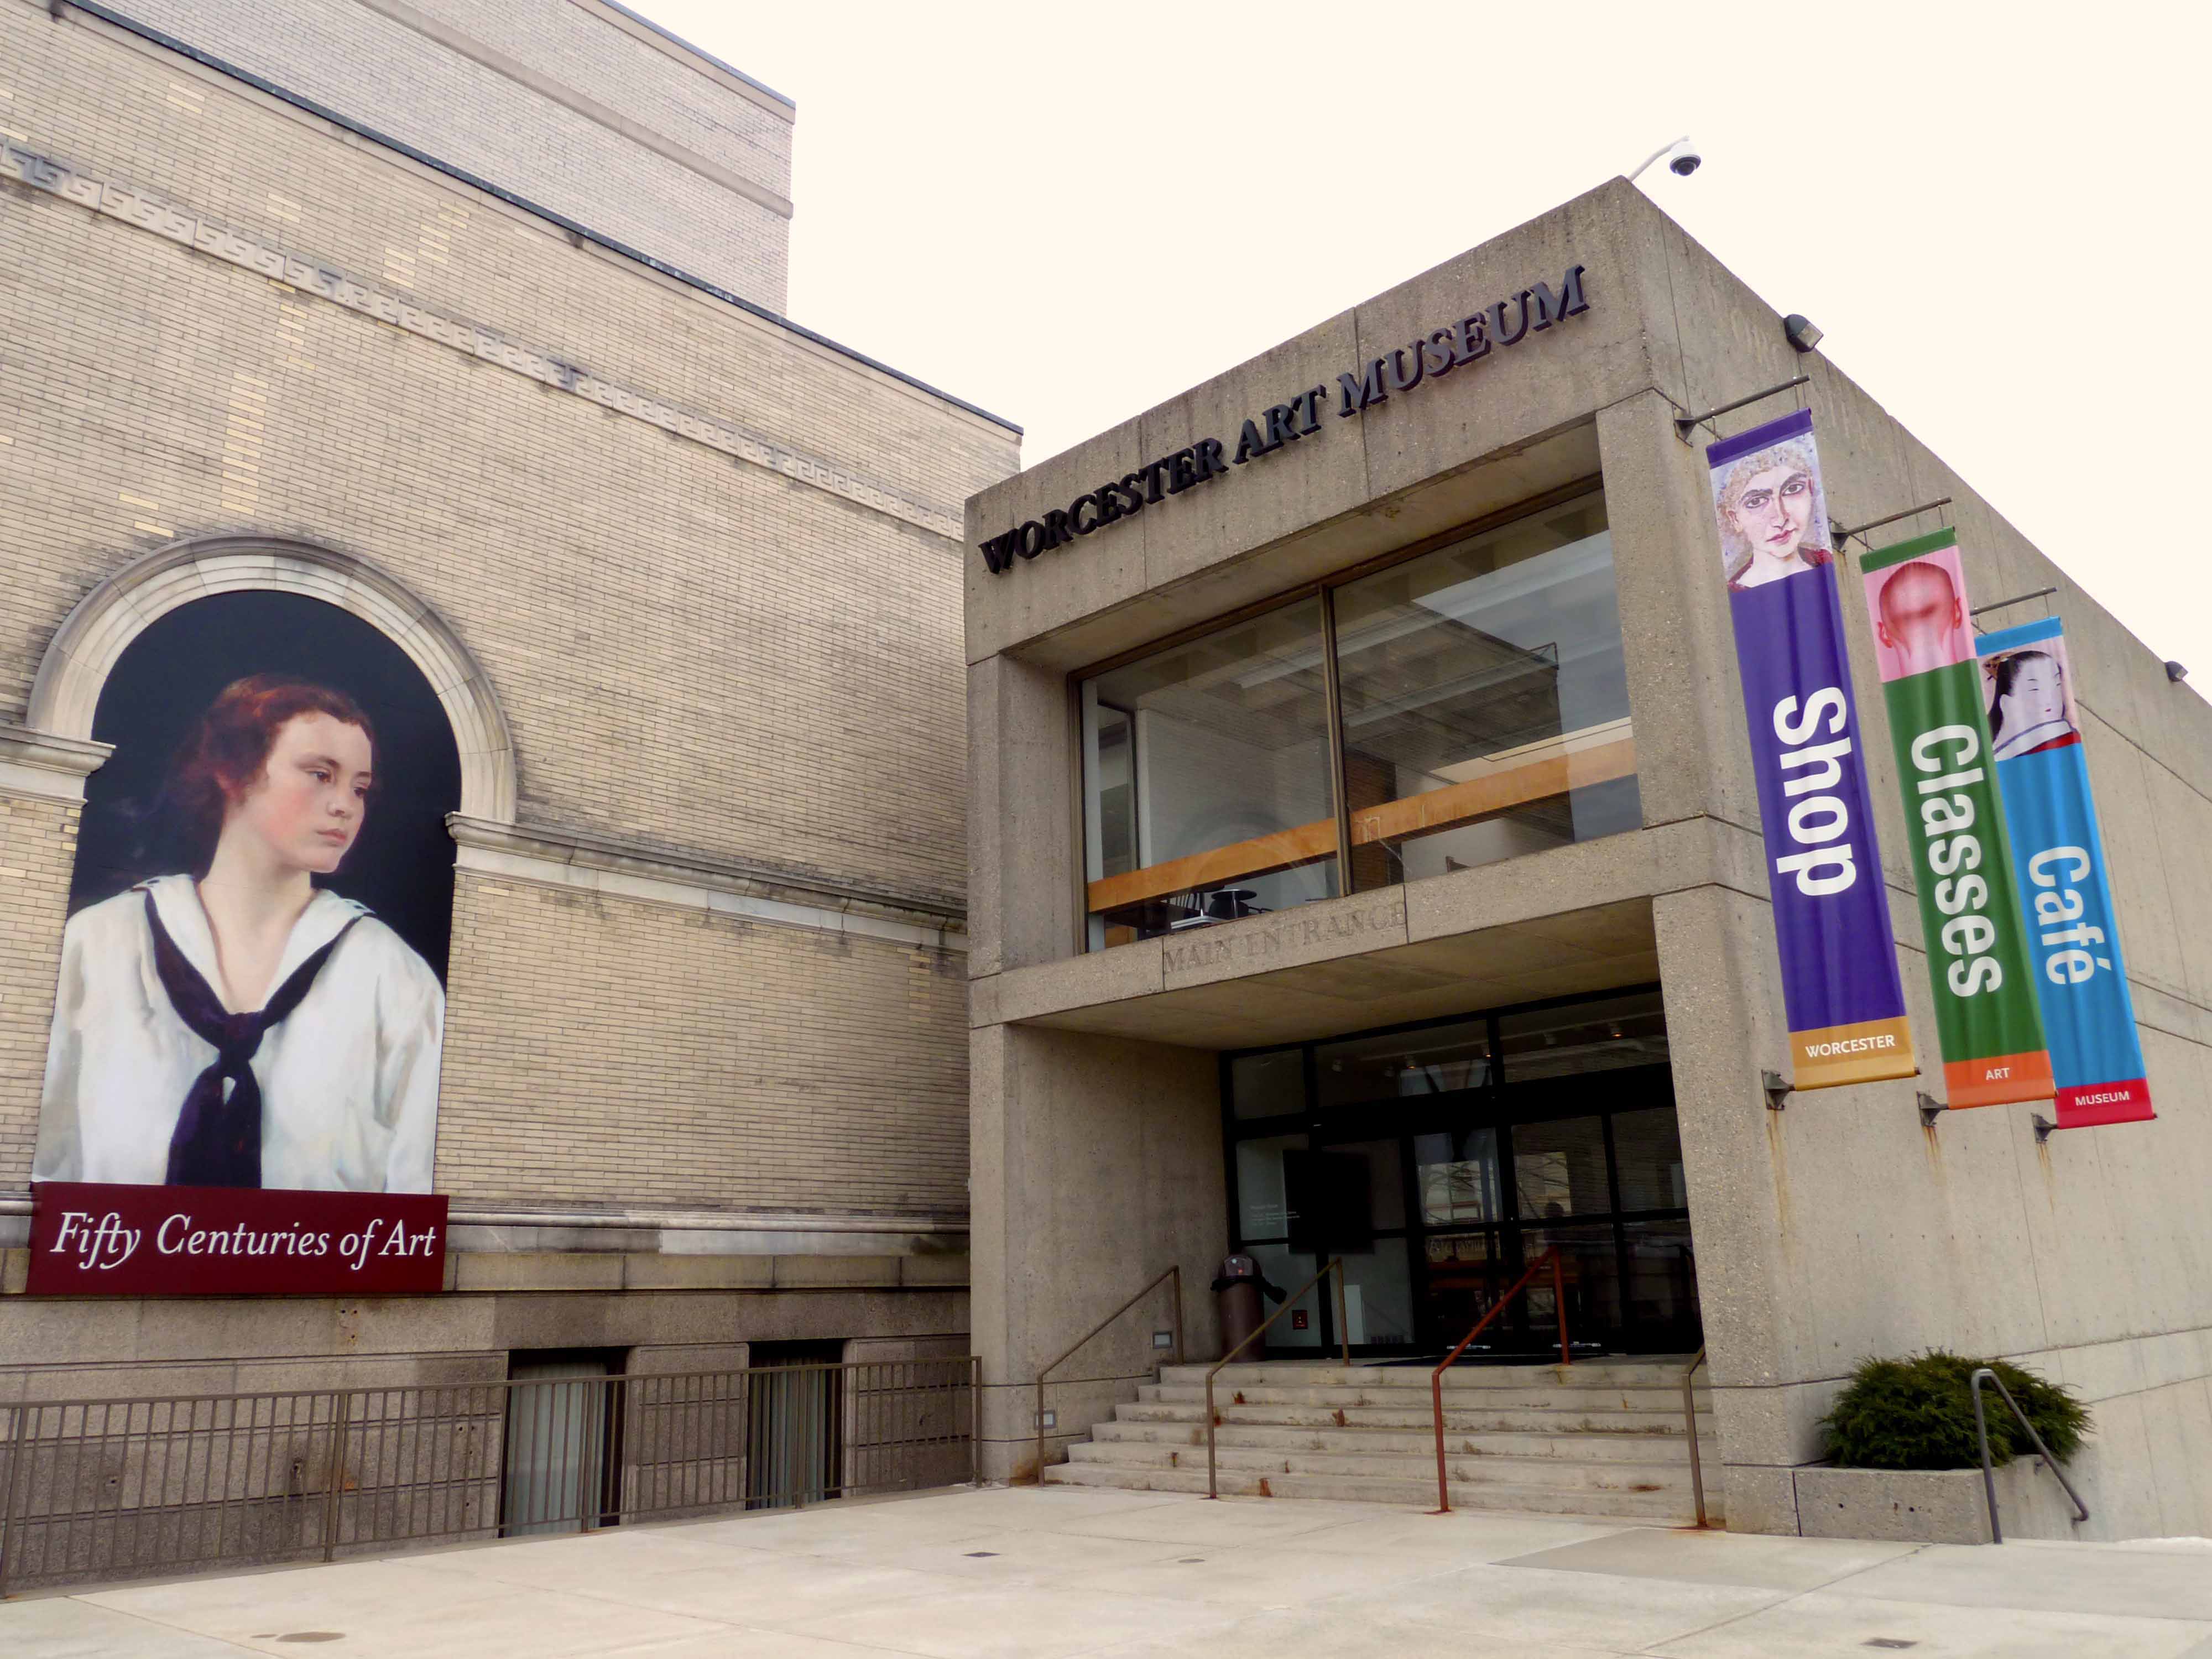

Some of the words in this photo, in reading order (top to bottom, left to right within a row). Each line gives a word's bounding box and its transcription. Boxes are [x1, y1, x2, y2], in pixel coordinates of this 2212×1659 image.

[978, 437, 1229, 575] WORCESTER
[1233, 384, 1326, 465] ART
[1338, 264, 1590, 418] MUSEUM
[1772, 686, 1857, 896] Shop
[1911, 724, 2003, 997] Classes
[1163, 940, 1235, 974] MAIN
[1246, 901, 1406, 956] ENTRANCE
[2028, 846, 2112, 985] Café
[1805, 1035, 1896, 1060] WORCESTER
[1985, 1067, 2010, 1081] ART
[2075, 1091, 2130, 1106] MUSEUM
[50, 1212, 141, 1270] Fifty
[157, 1214, 329, 1257] Centuries
[339, 1218, 383, 1270] of
[379, 1219, 436, 1257] Art
